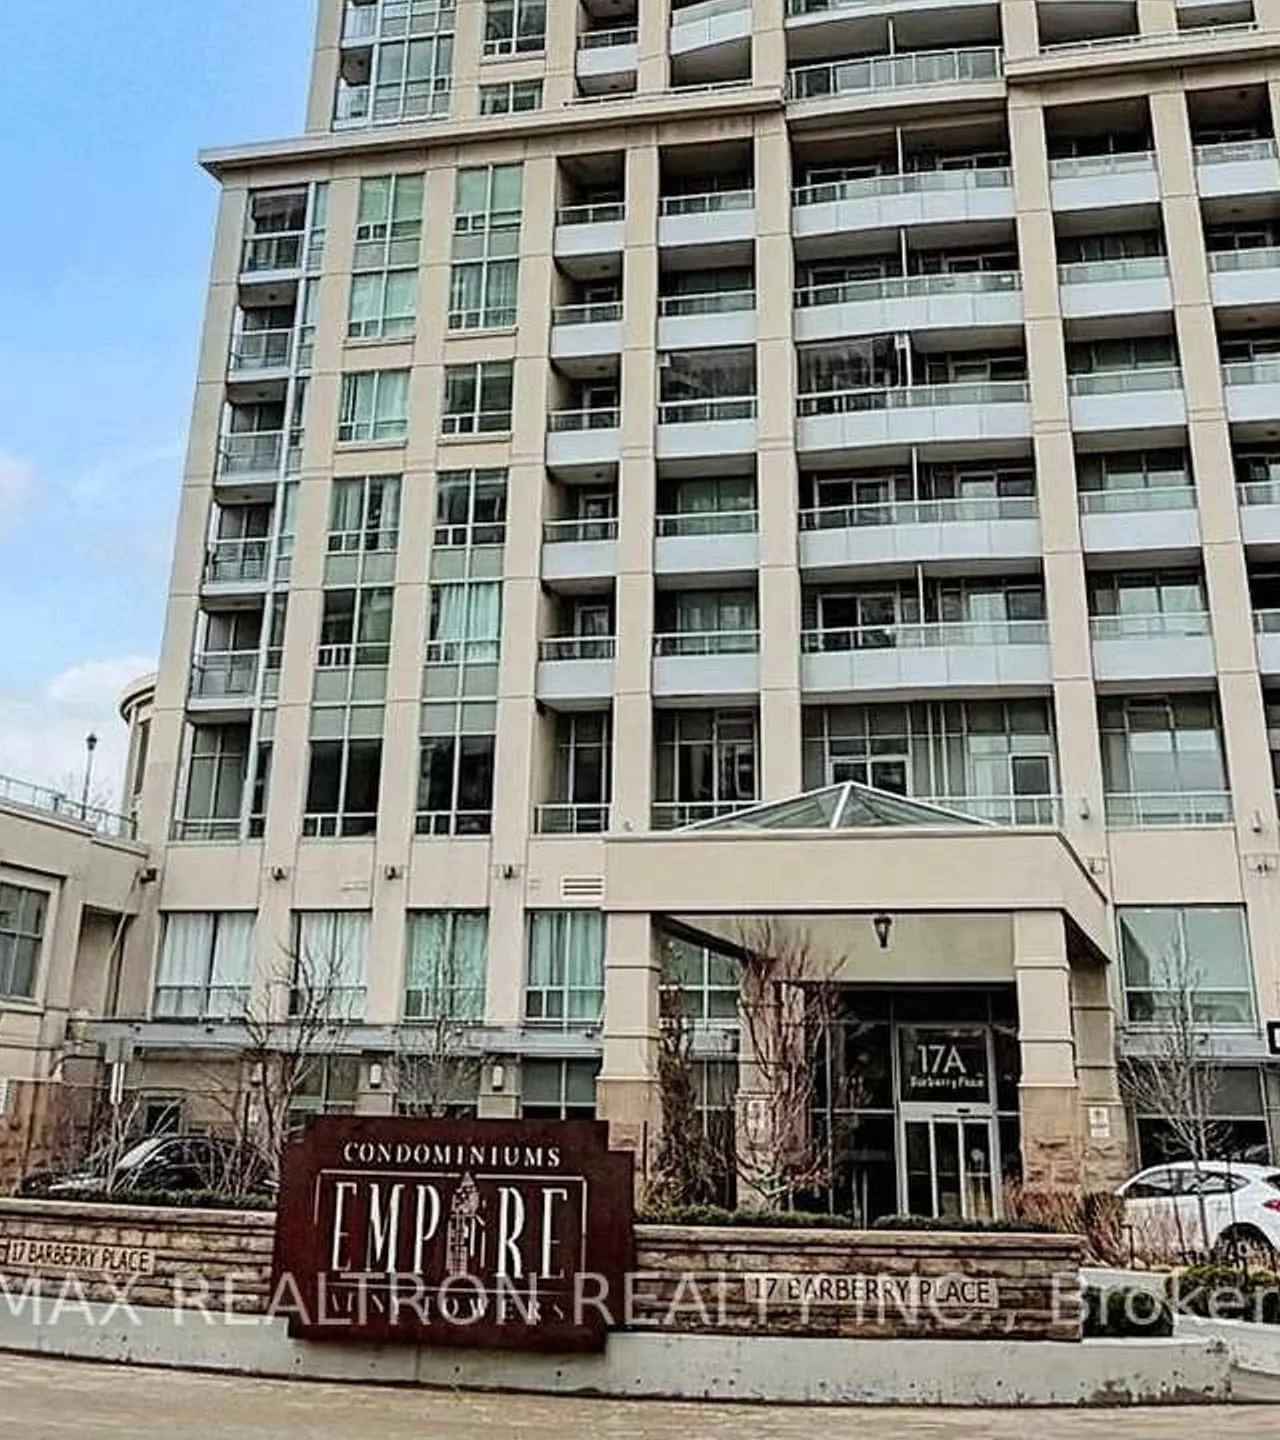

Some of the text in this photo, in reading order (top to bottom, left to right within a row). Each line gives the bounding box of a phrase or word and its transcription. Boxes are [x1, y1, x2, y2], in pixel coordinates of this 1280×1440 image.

[917, 1044, 967, 1074] 17A
[343, 1142, 561, 1168] CONDOMINIUMS
[331, 1179, 568, 1280] EMPIRE
[11, 1241, 150, 1273] 17 BARBERRY PLACE
[753, 1277, 990, 1304] 17 BARBERRY PLACE
